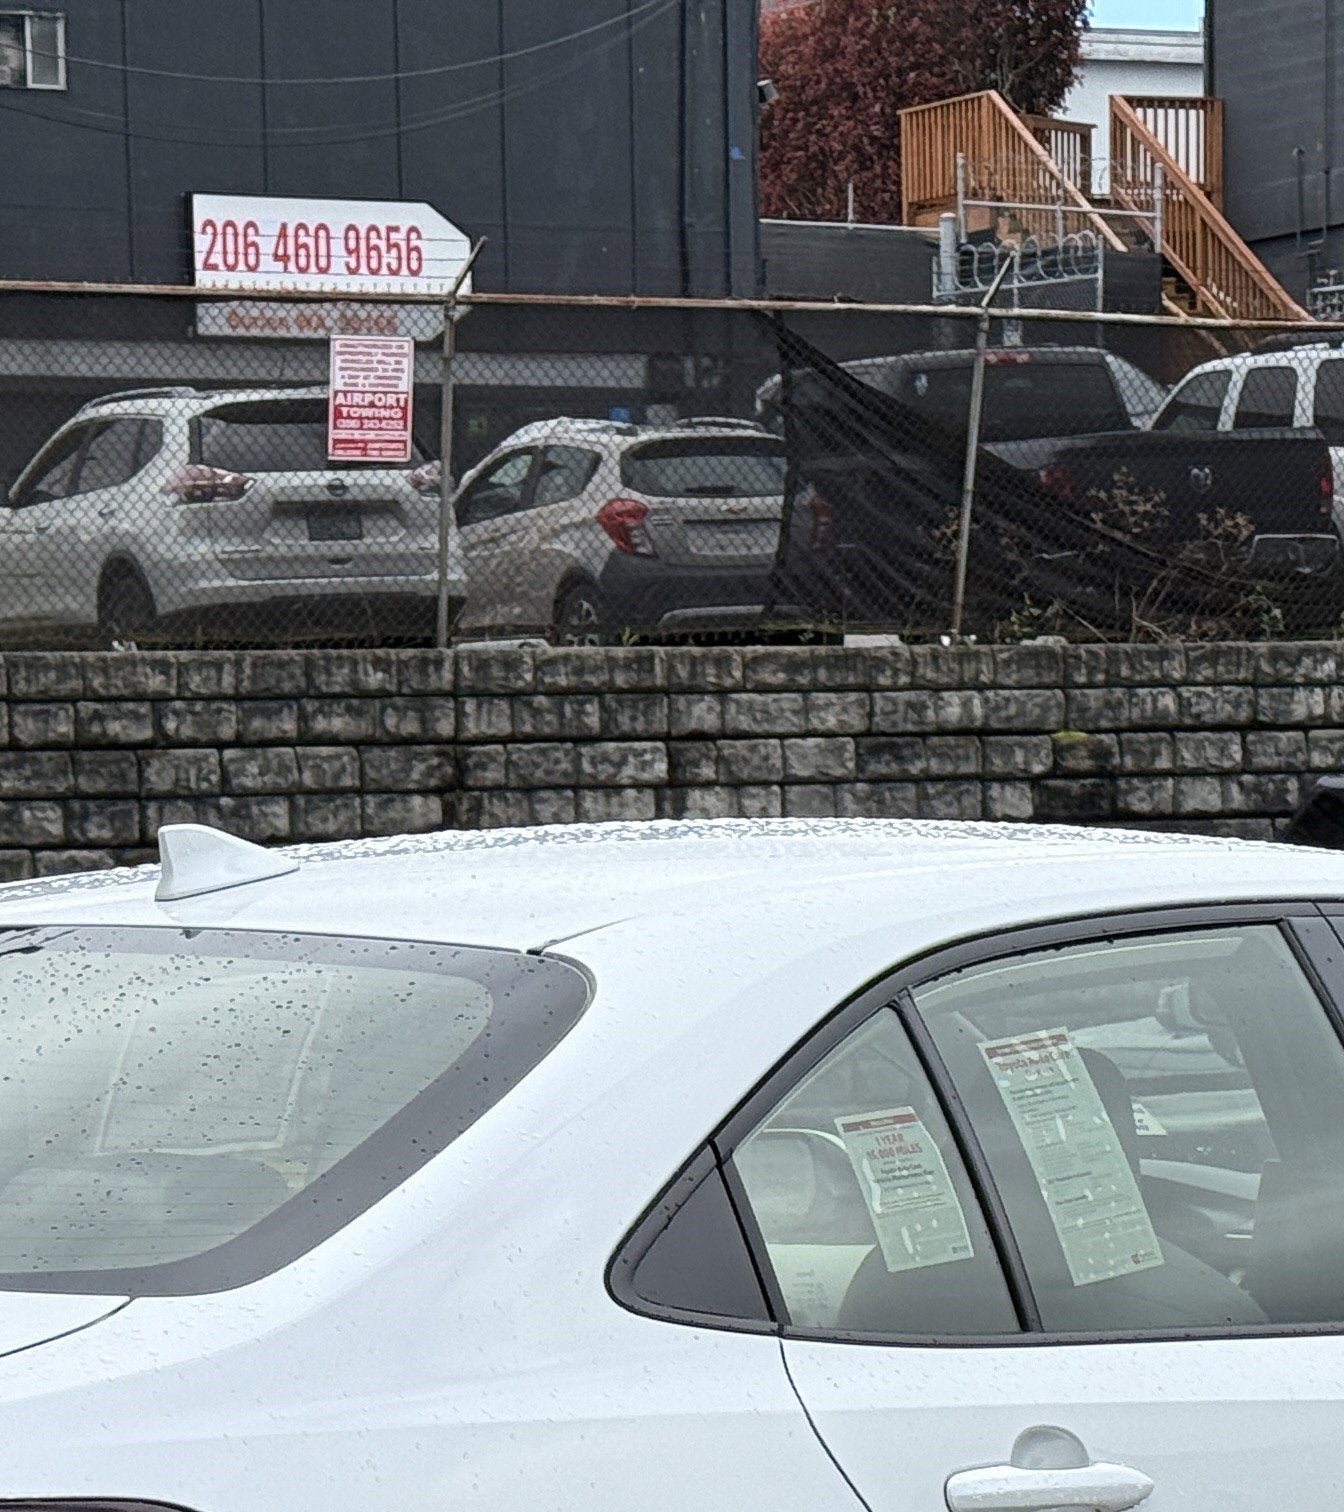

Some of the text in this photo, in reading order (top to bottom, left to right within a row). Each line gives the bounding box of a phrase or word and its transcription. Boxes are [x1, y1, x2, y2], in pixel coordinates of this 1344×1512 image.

[200, 219, 424, 277] 206 460 9656
[335, 392, 408, 407] AIRPORT
[341, 407, 403, 418] TOWING
